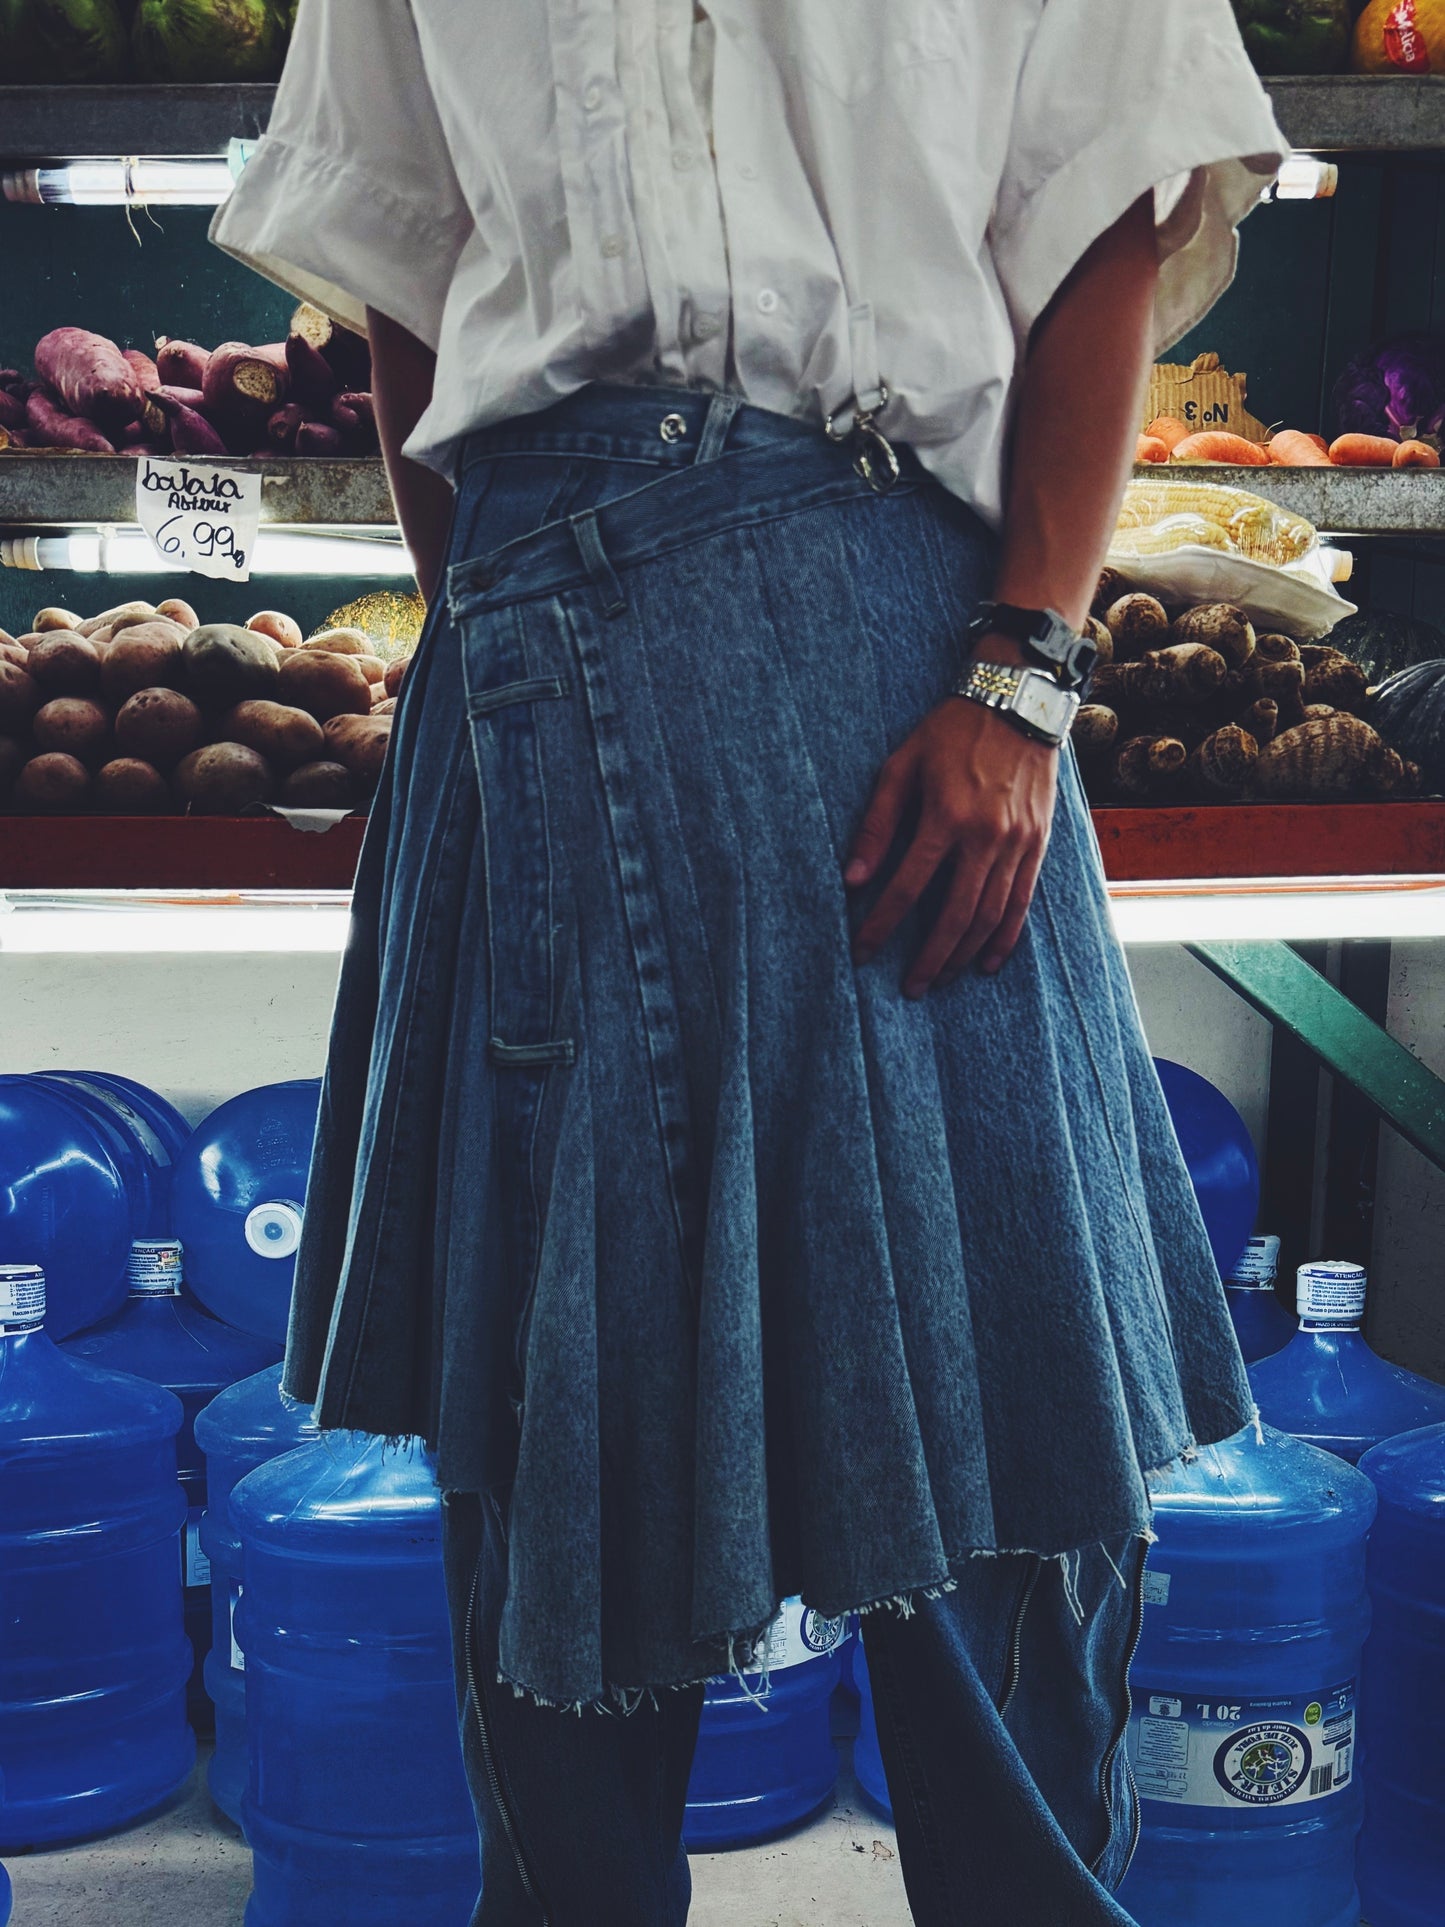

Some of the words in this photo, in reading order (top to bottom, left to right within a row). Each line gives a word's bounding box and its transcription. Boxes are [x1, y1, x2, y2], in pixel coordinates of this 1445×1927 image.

[1196, 1703, 1210, 1719] L
[1217, 1705, 1242, 1720] 20
[1232, 1769, 1298, 1794] SIERRA
